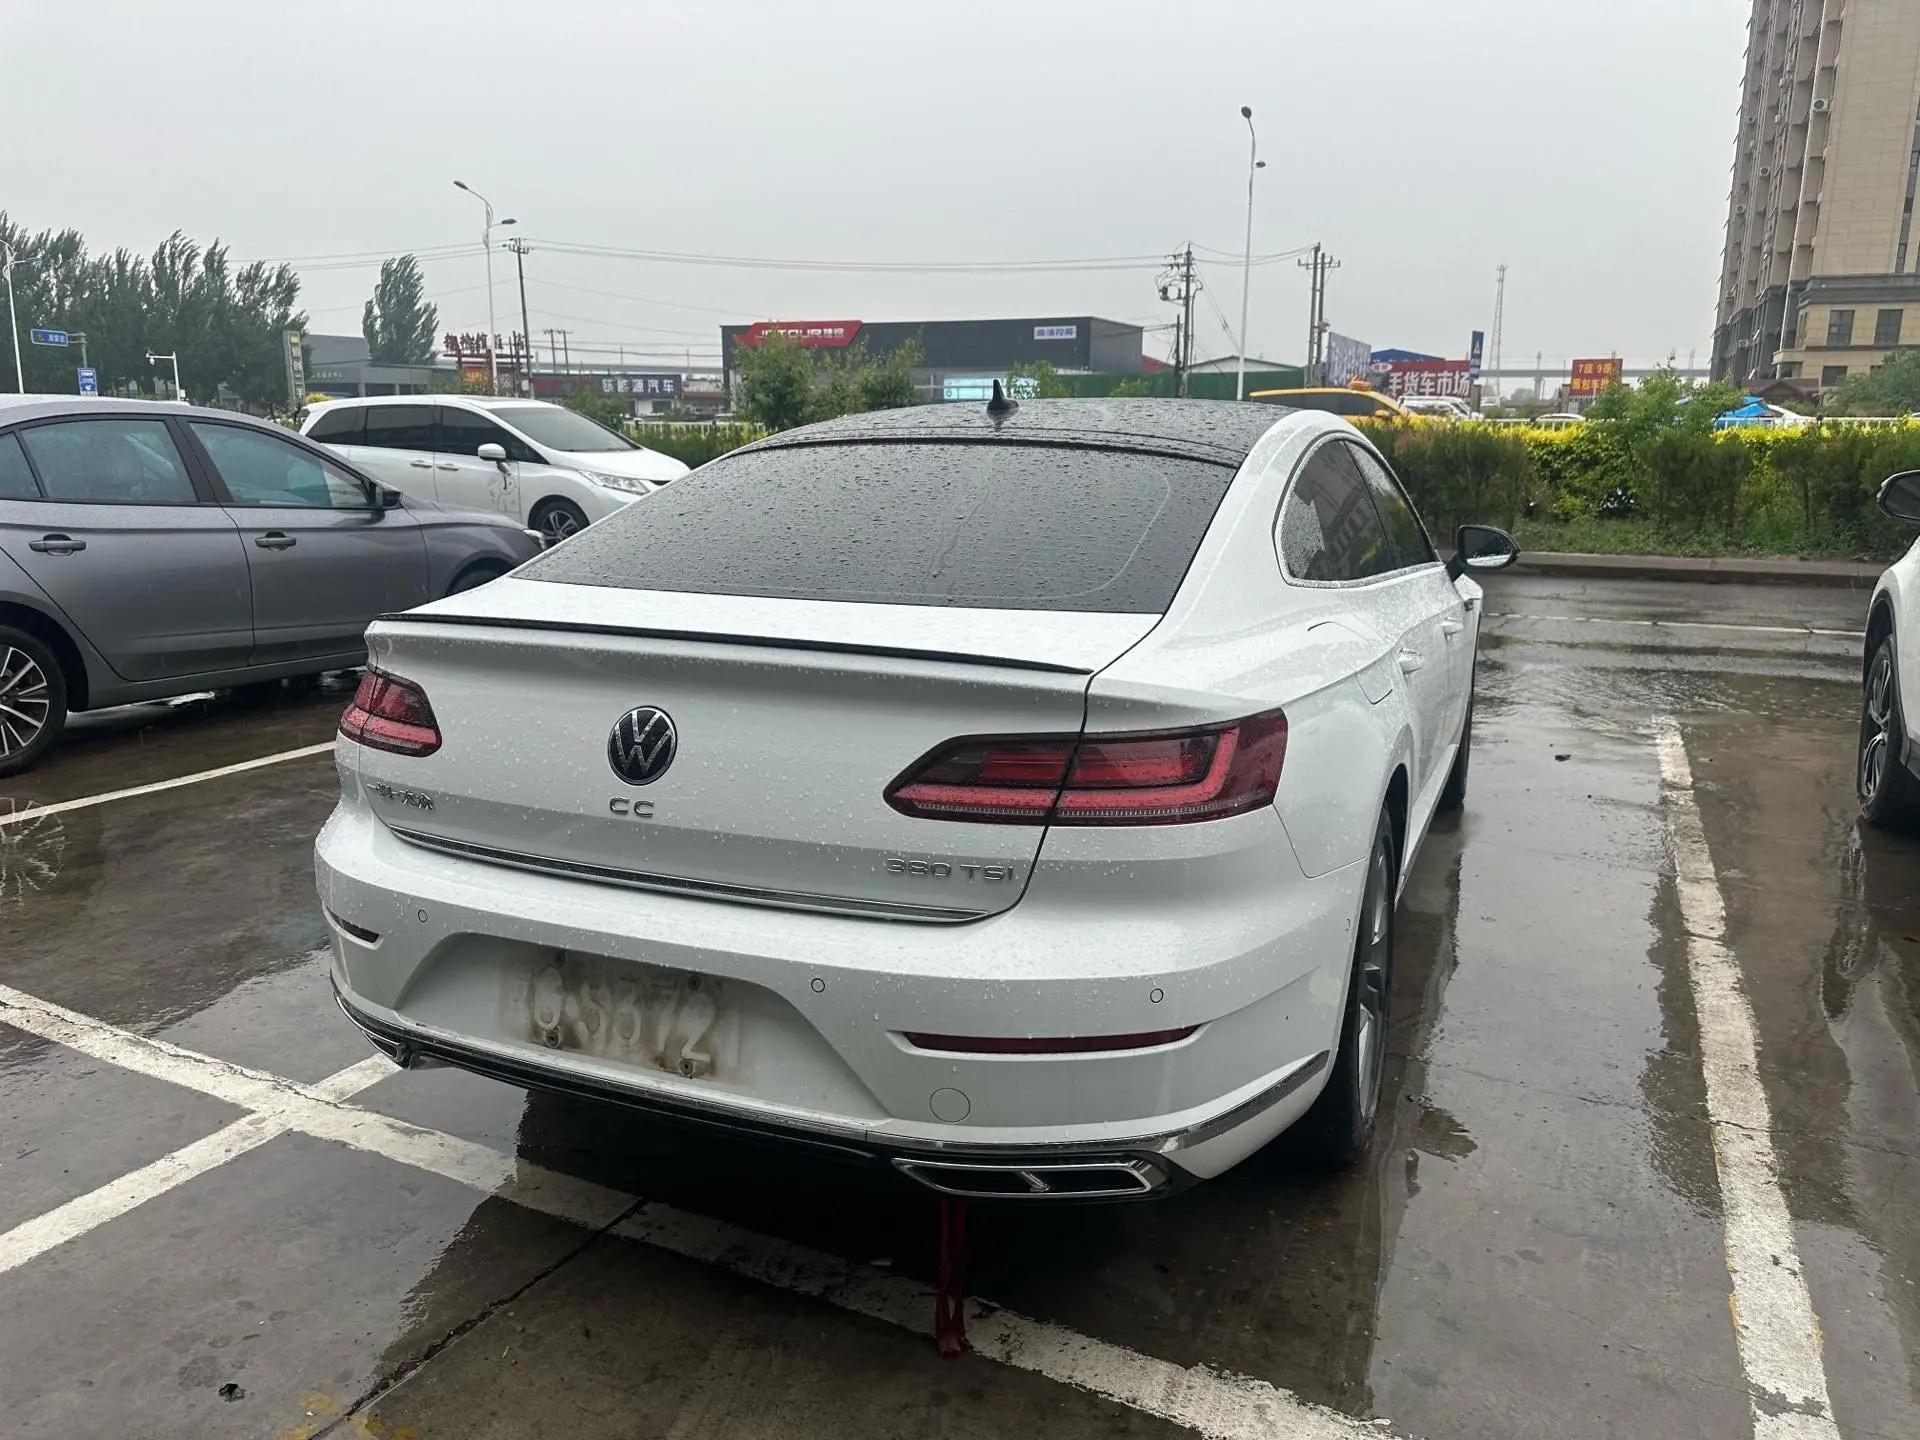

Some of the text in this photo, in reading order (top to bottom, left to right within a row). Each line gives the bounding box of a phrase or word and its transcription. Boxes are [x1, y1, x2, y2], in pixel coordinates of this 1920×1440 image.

[602, 378, 674, 393] 新能源汽车
[609, 796, 655, 818] CC
[886, 857, 1014, 881] 380 TSI
